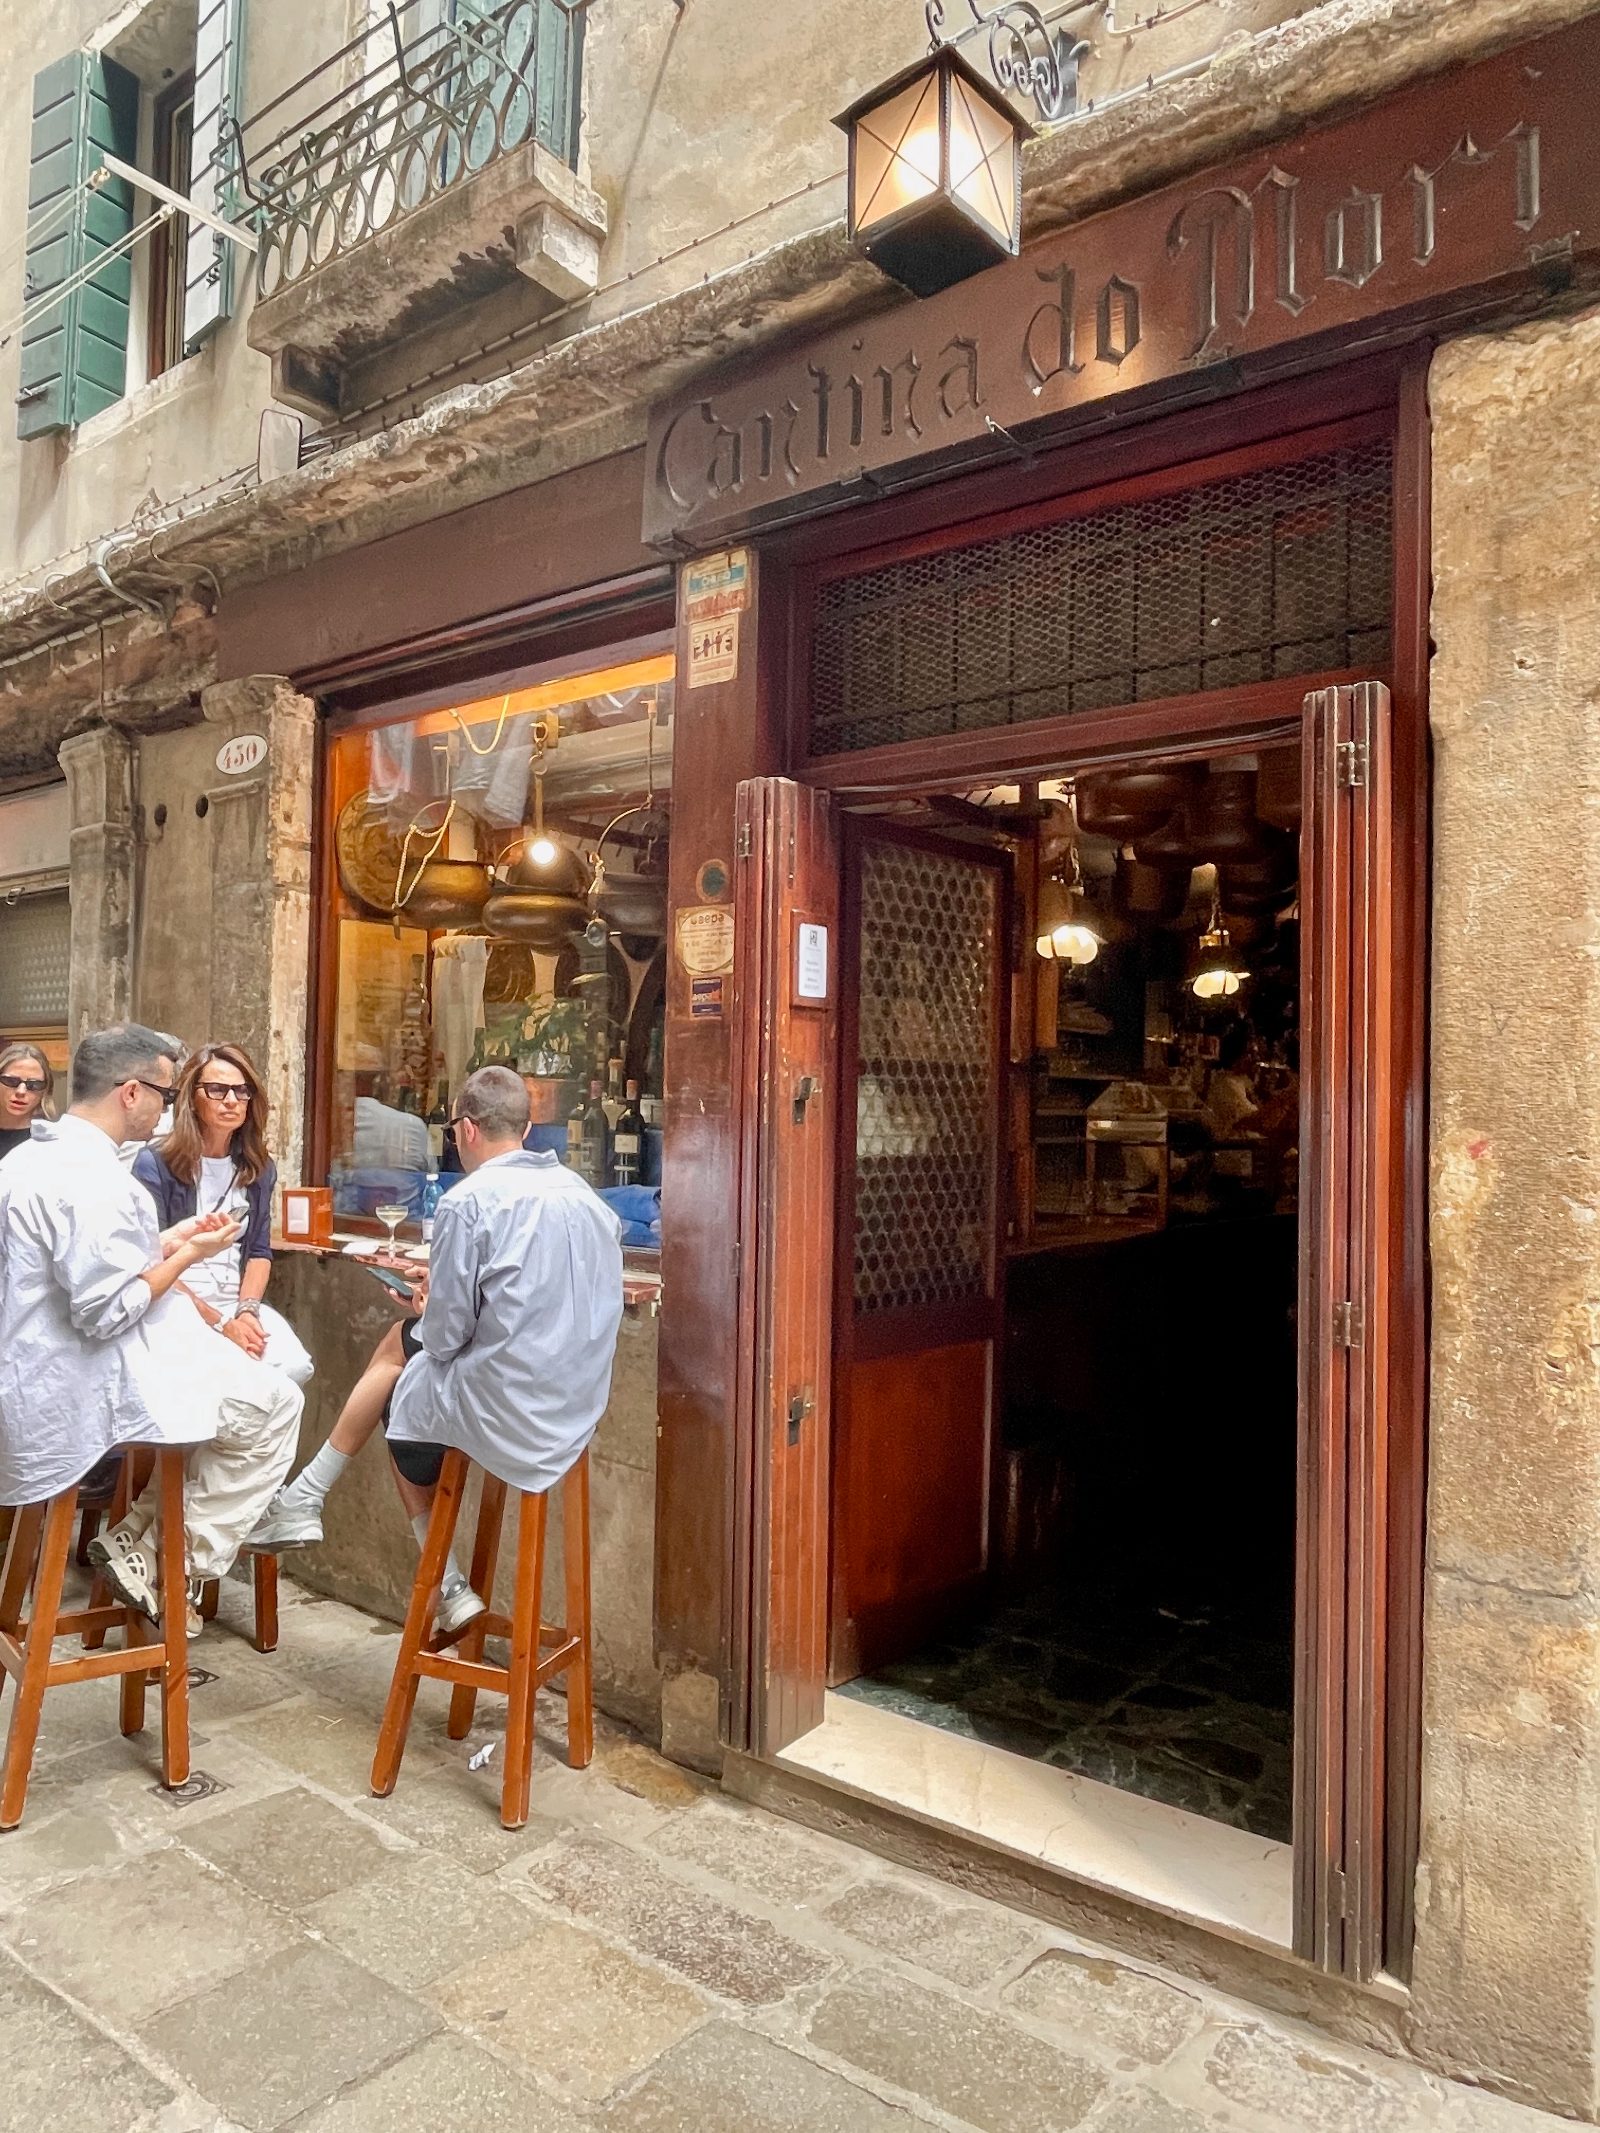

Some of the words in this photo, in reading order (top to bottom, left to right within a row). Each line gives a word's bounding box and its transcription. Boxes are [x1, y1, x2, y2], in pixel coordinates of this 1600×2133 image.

[655, 333, 988, 508] Cantina
[1022, 261, 1144, 397] do
[1166, 120, 1541, 355] Mori
